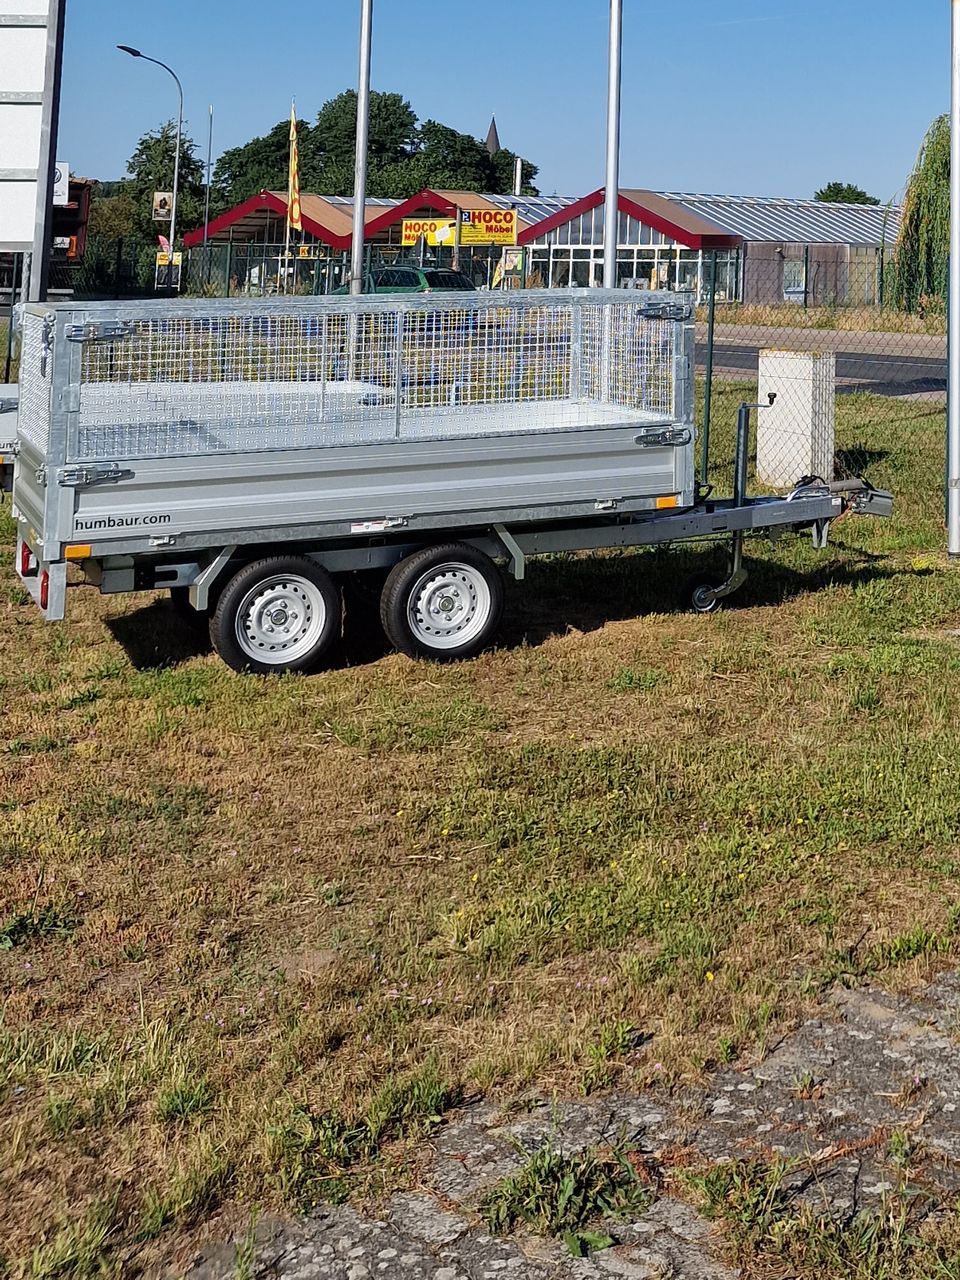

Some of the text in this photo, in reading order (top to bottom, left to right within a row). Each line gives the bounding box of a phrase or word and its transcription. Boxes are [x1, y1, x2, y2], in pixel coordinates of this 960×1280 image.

[471, 211, 514, 224] HOCO
[404, 222, 437, 233] HOCO
[485, 224, 513, 234] Möbel
[75, 514, 171, 531] humbaur.com
